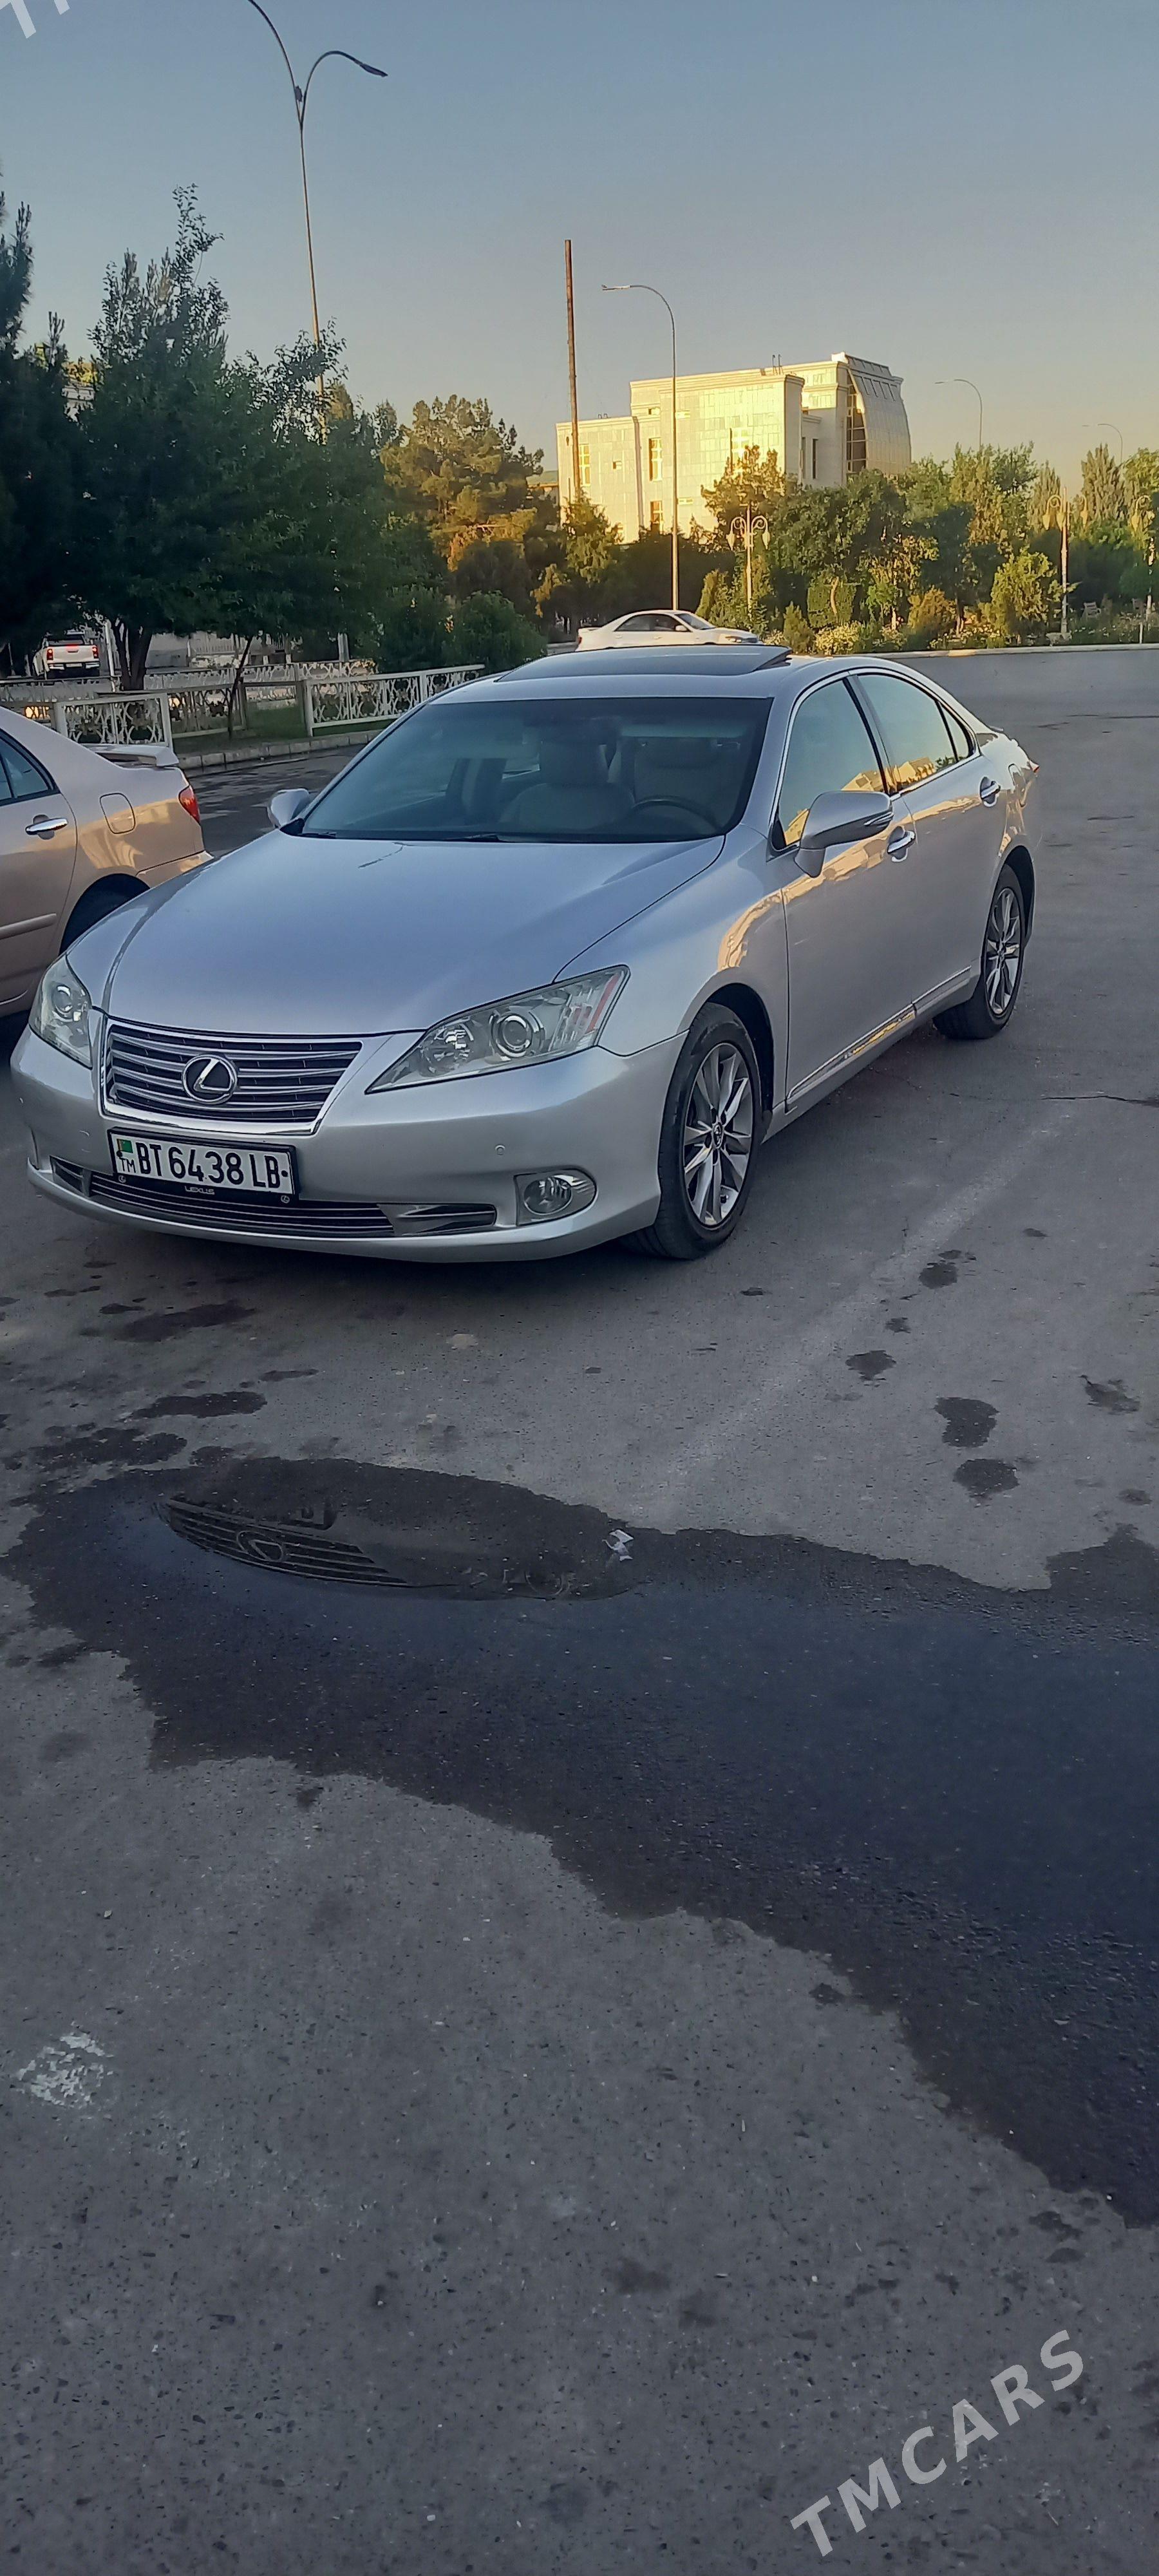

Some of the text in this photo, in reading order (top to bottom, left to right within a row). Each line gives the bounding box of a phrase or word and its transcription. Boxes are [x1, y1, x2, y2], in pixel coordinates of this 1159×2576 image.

[119, 1157, 137, 1173] TM
[135, 1142, 281, 1188] BT 6438 LB
[184, 1186, 215, 1195] LEXUS
